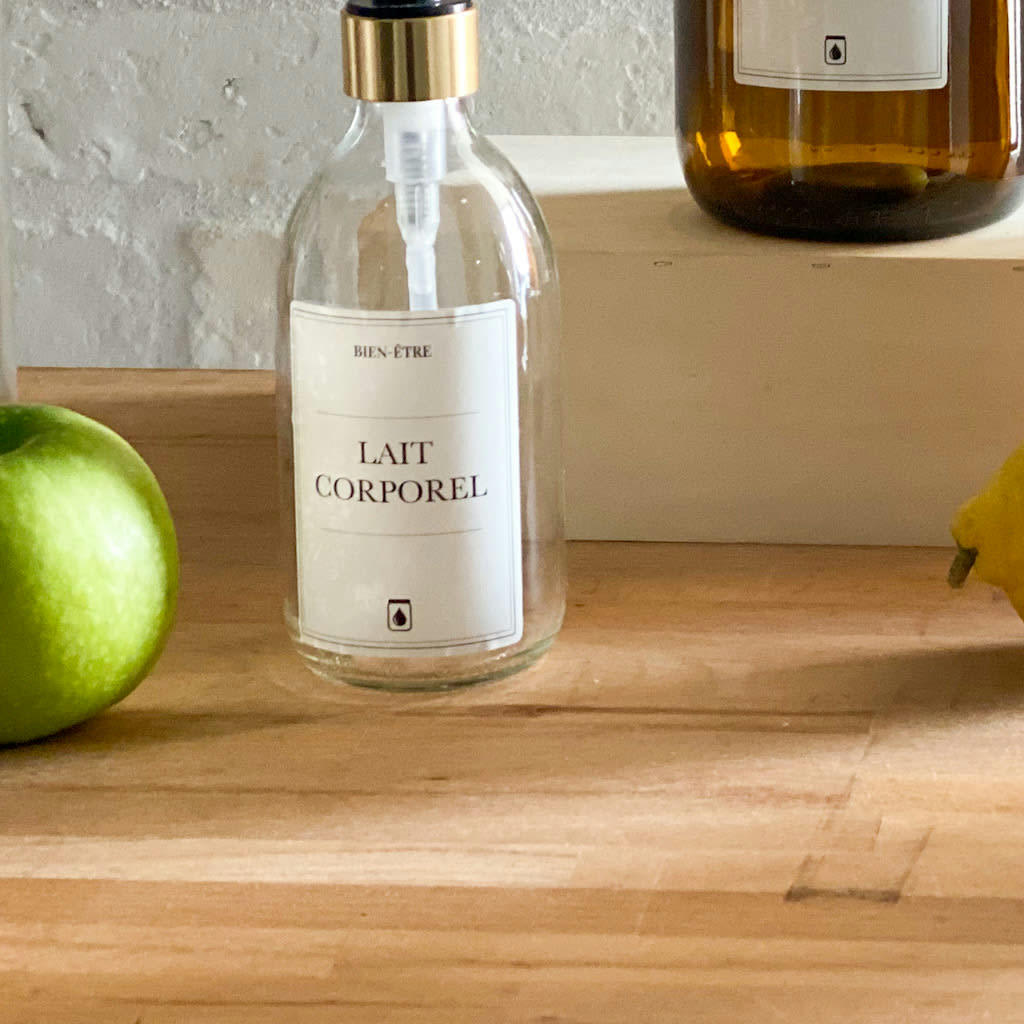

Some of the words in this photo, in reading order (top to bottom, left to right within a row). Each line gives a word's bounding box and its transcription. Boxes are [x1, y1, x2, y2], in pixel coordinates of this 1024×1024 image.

[353, 344, 432, 359] BIEN-ÊTRE
[358, 440, 434, 465] LAIT
[315, 474, 488, 504] CORPOREL
